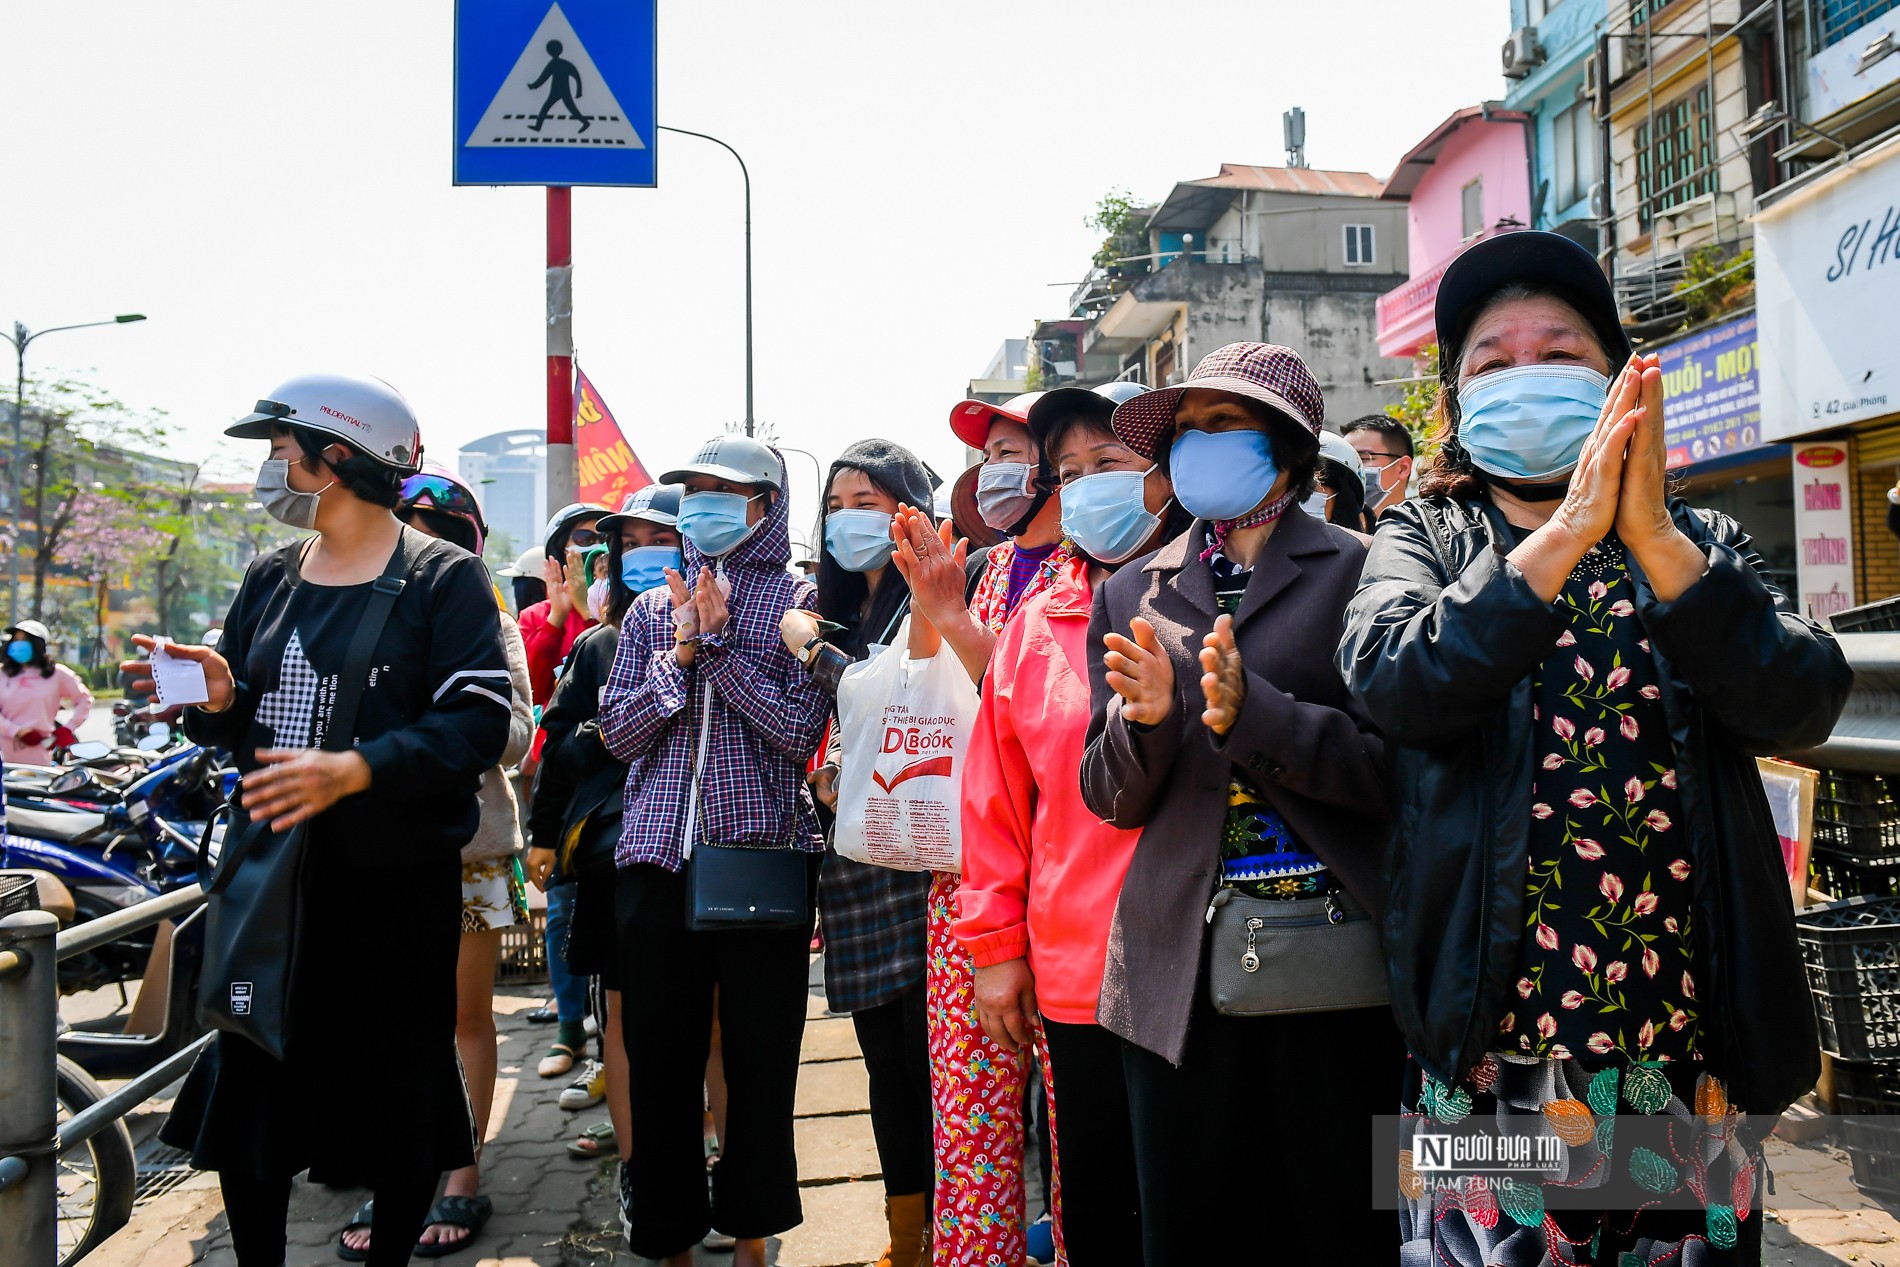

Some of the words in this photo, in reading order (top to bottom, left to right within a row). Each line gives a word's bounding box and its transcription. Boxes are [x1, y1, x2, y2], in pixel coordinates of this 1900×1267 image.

[1826, 219, 1871, 282] SI
[1826, 399, 1840, 415] 42
[320, 405, 360, 428] PRUDENTIAL
[1804, 477, 1842, 511] HÀNG
[1803, 532, 1848, 566] THÙNG
[329, 674, 338, 691] tion
[368, 667, 379, 687] etiro
[319, 686, 327, 704] with
[328, 692, 336, 705] me
[317, 705, 325, 718] are
[315, 721, 324, 736] you
